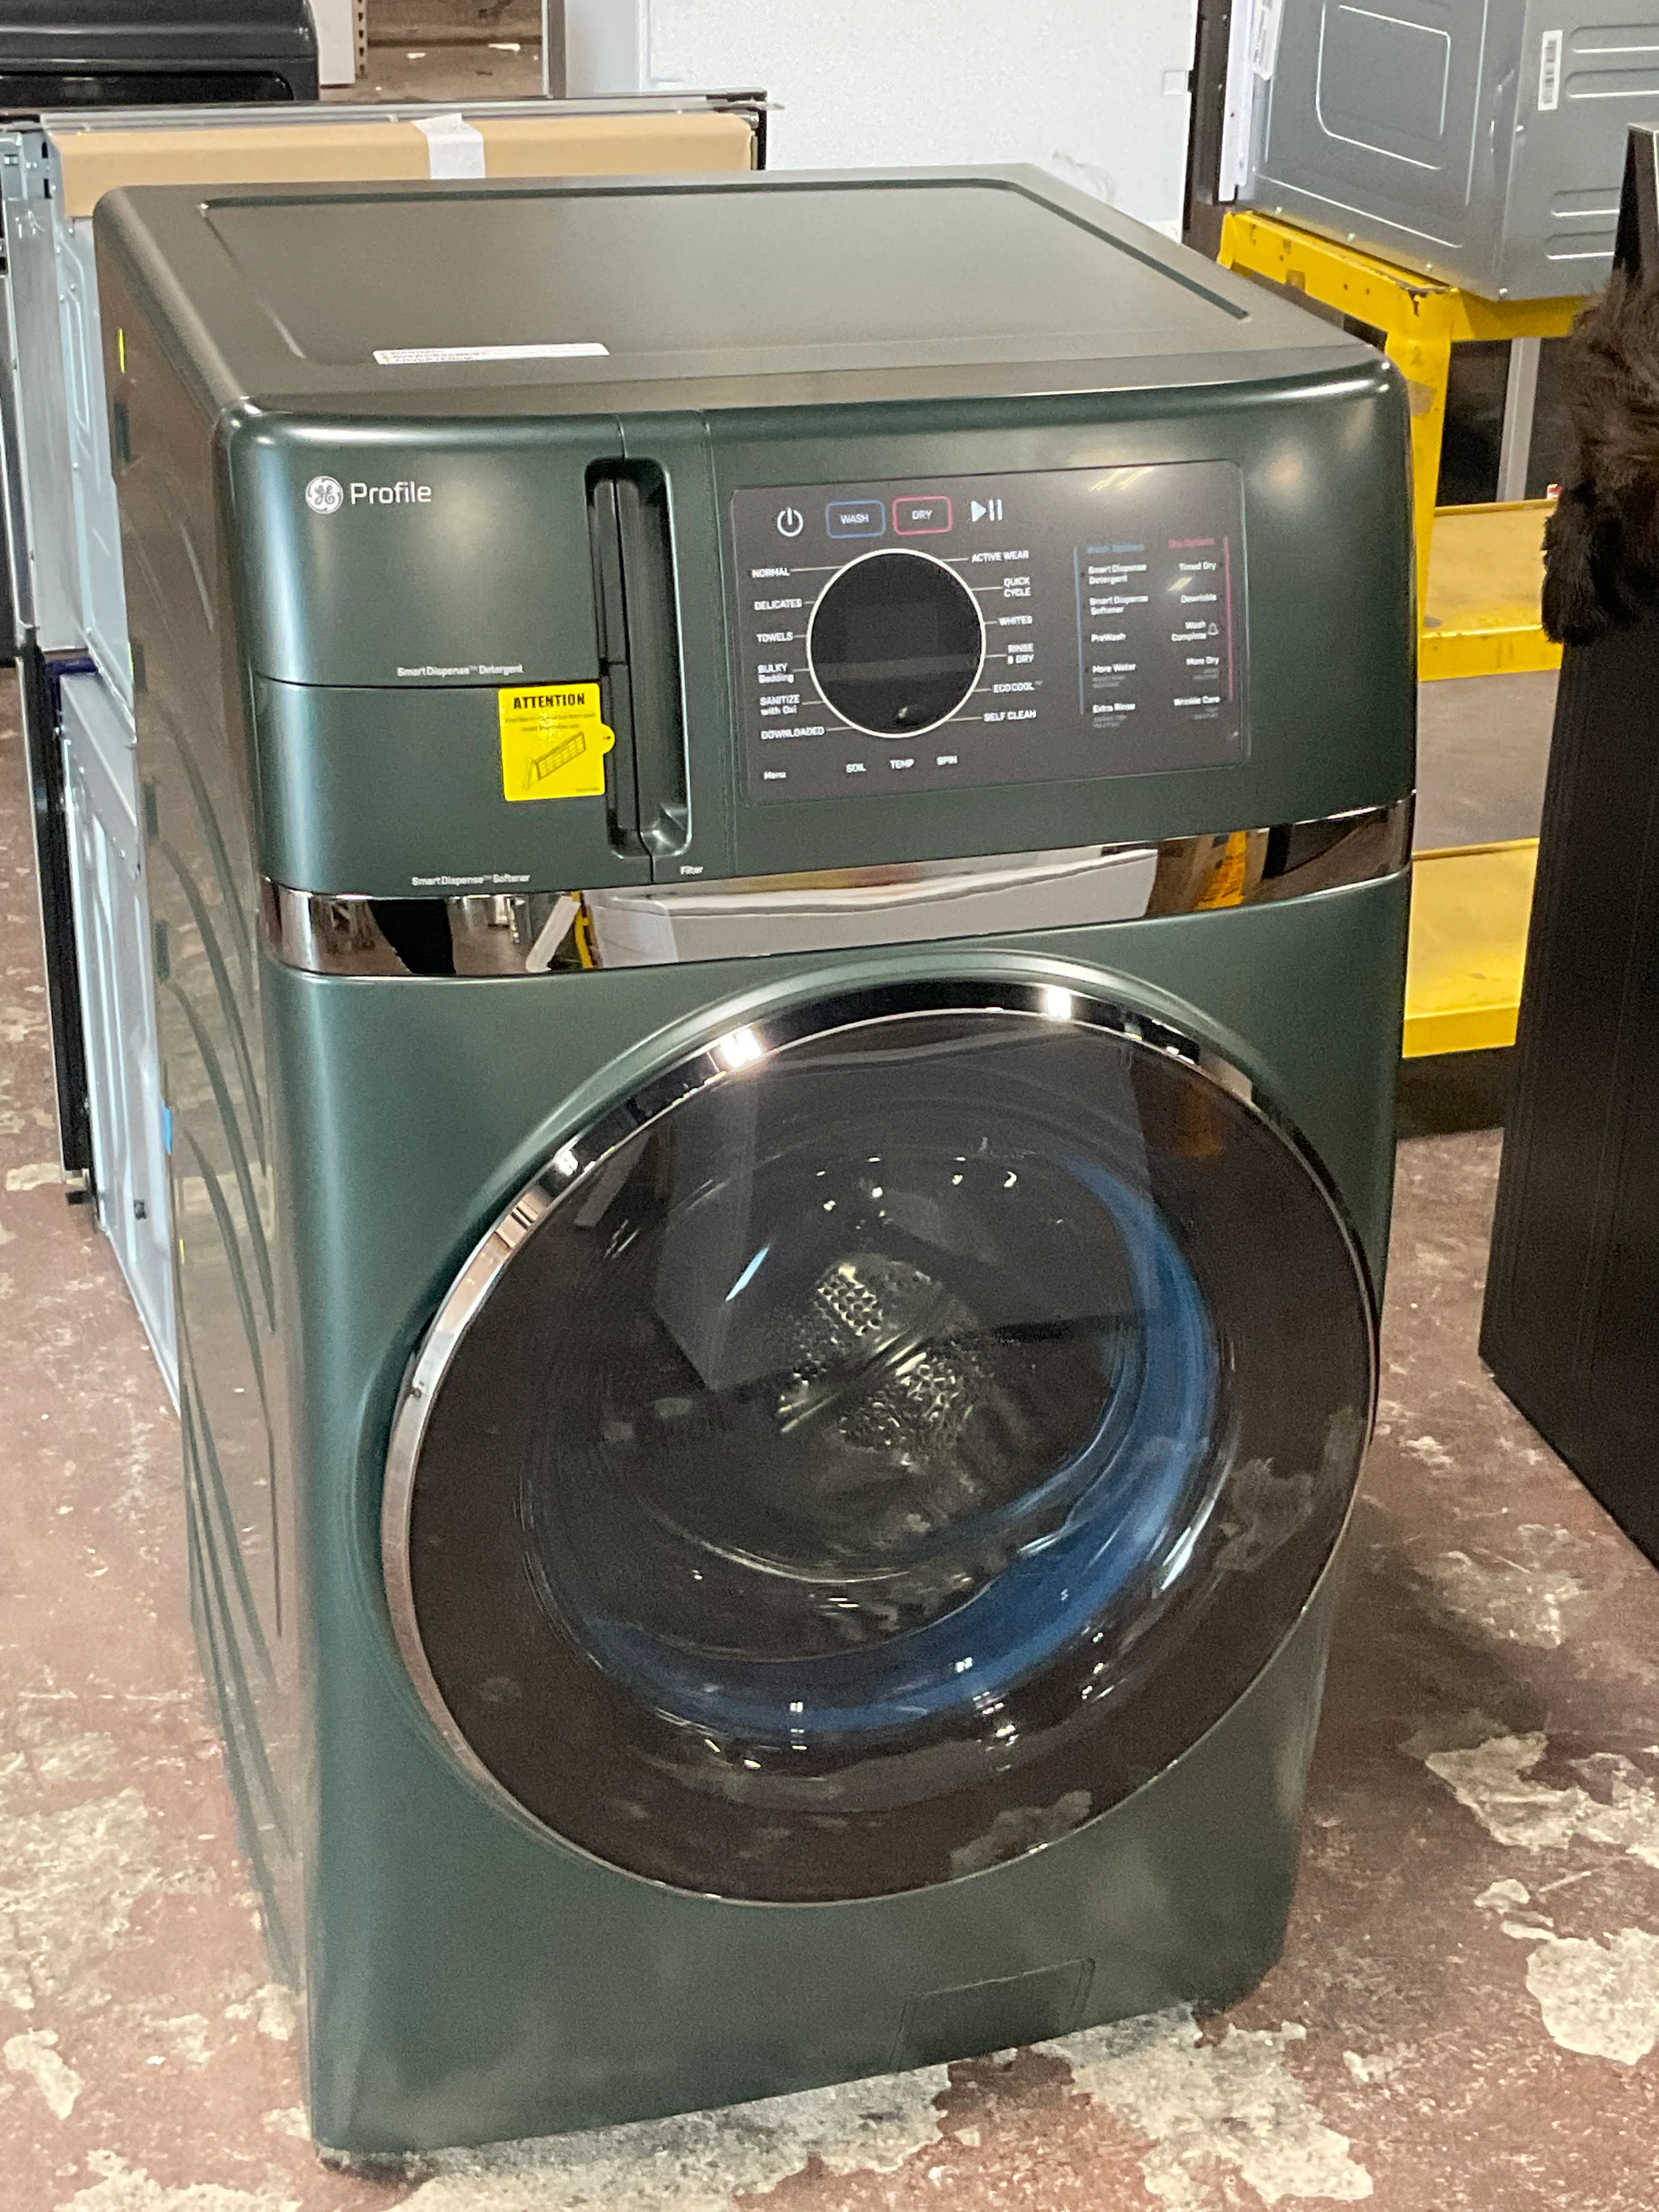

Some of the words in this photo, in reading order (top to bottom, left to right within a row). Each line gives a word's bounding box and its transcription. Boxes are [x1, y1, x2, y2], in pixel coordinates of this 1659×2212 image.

[351, 481, 432, 505] Profile
[840, 514, 869, 524] WASH
[911, 510, 933, 520] DRY
[972, 552, 1002, 563] ACTIVE
[1003, 550, 1029, 560] WEAR
[752, 567, 790, 578] NORMAL
[1003, 576, 1030, 588] QUICK
[1003, 586, 1031, 597] CYCLE
[754, 598, 802, 611] DELICATES
[998, 616, 1033, 626] WHITES
[756, 631, 794, 642] TOWELS
[1015, 654, 1035, 664] DRY
[478, 663, 524, 676] Detergent
[758, 663, 788, 674] BULKY
[514, 692, 585, 710] ATTENTION
[759, 694, 800, 706] SANITIZE
[983, 712, 1006, 722] SELF
[1007, 709, 1037, 720] CLEAN
[760, 726, 825, 740] DOWNLOADED
[889, 758, 915, 769] TEMP
[493, 873, 531, 884] Softener
